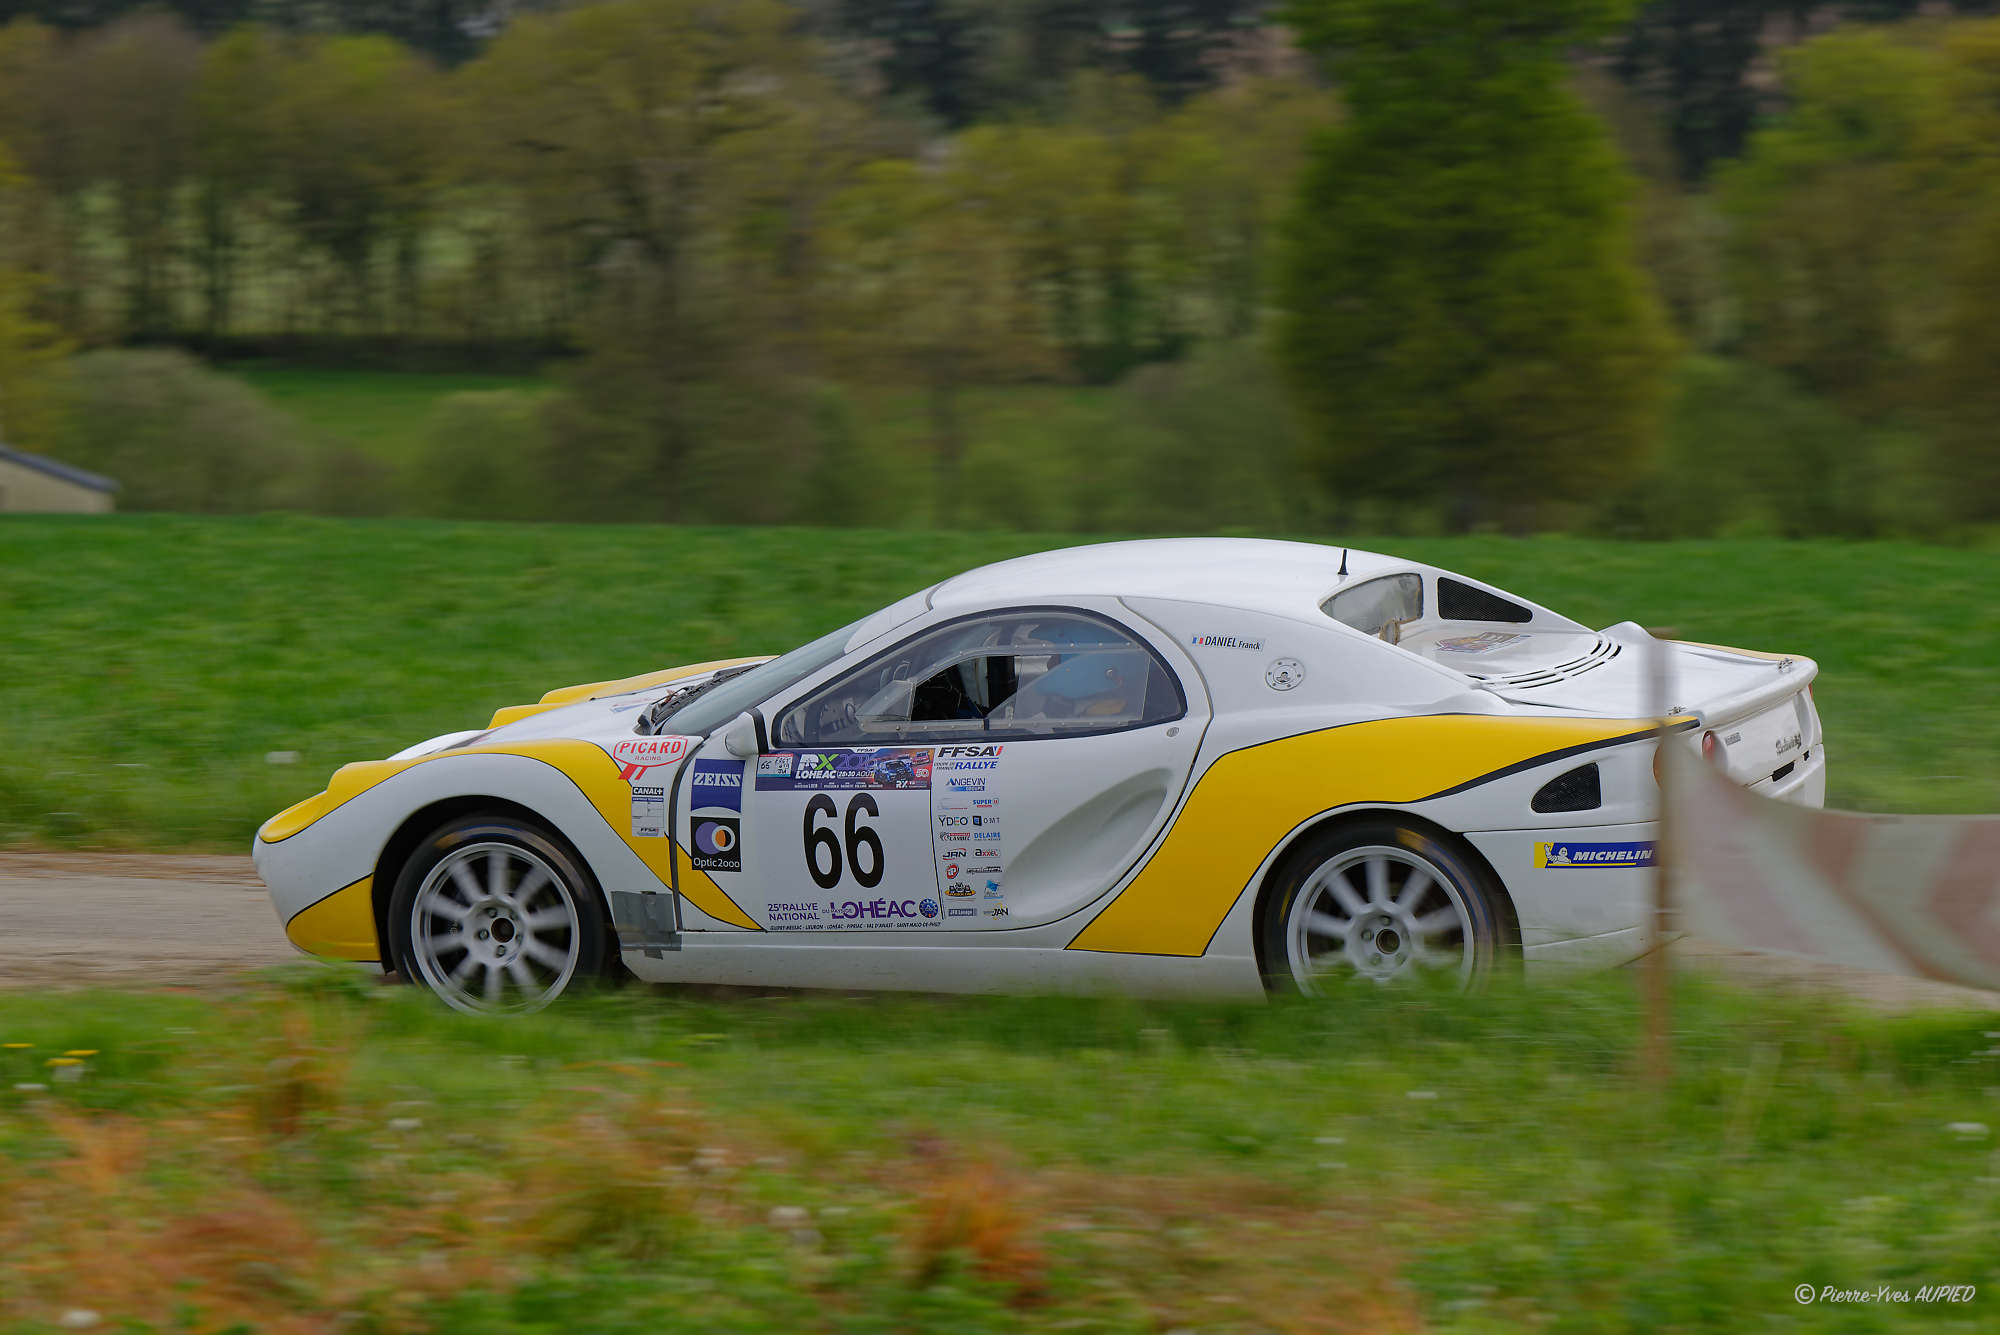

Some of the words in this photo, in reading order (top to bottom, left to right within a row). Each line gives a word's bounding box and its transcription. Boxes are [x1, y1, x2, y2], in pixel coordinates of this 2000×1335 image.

[1205, 636, 1236, 648] DANIEL
[1238, 640, 1260, 650] Franck
[619, 740, 682, 754] PICARD
[938, 746, 997, 757] FFSA
[954, 761, 998, 770] RALLYE
[694, 772, 741, 787] ZEISS
[795, 770, 836, 779] LOHEAC
[945, 778, 985, 786] ANGEVIN
[633, 787, 663, 795] CANAL+
[803, 792, 885, 890] 66
[1573, 850, 1653, 861] MICHELIN
[782, 903, 818, 911] RALLYE
[830, 898, 918, 919] LOHÉAC
[769, 912, 820, 921] NATIONAL
